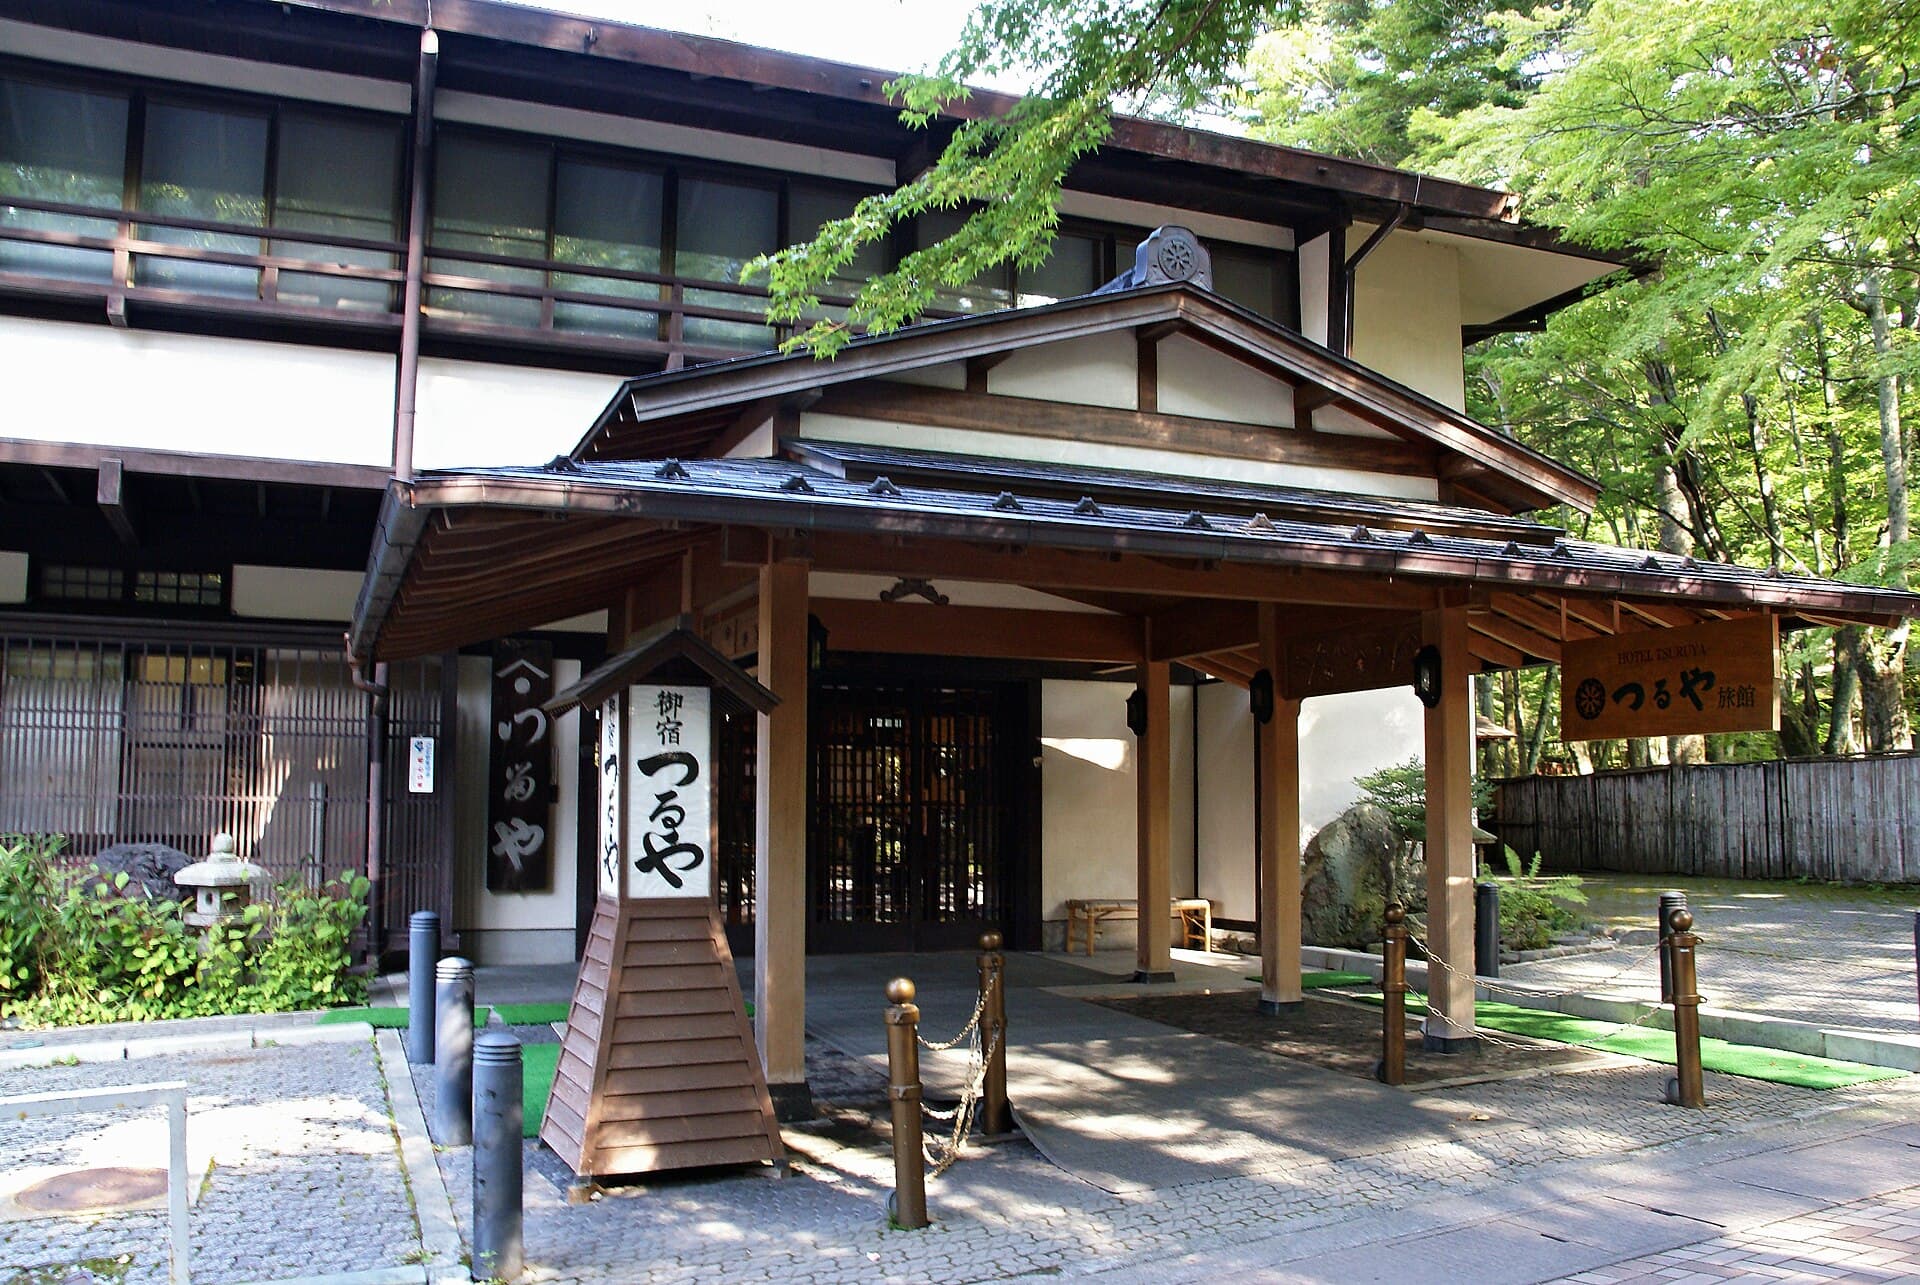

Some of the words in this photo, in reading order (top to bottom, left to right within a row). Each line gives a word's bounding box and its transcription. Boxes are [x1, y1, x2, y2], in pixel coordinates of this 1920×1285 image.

[1618, 649, 1653, 665] HOTEL
[1656, 643, 1708, 661] TSURUYA
[1612, 667, 1715, 711] つるや
[1718, 684, 1756, 710] 旅館
[654, 690, 683, 746] 御宿
[634, 751, 704, 889] つるや
